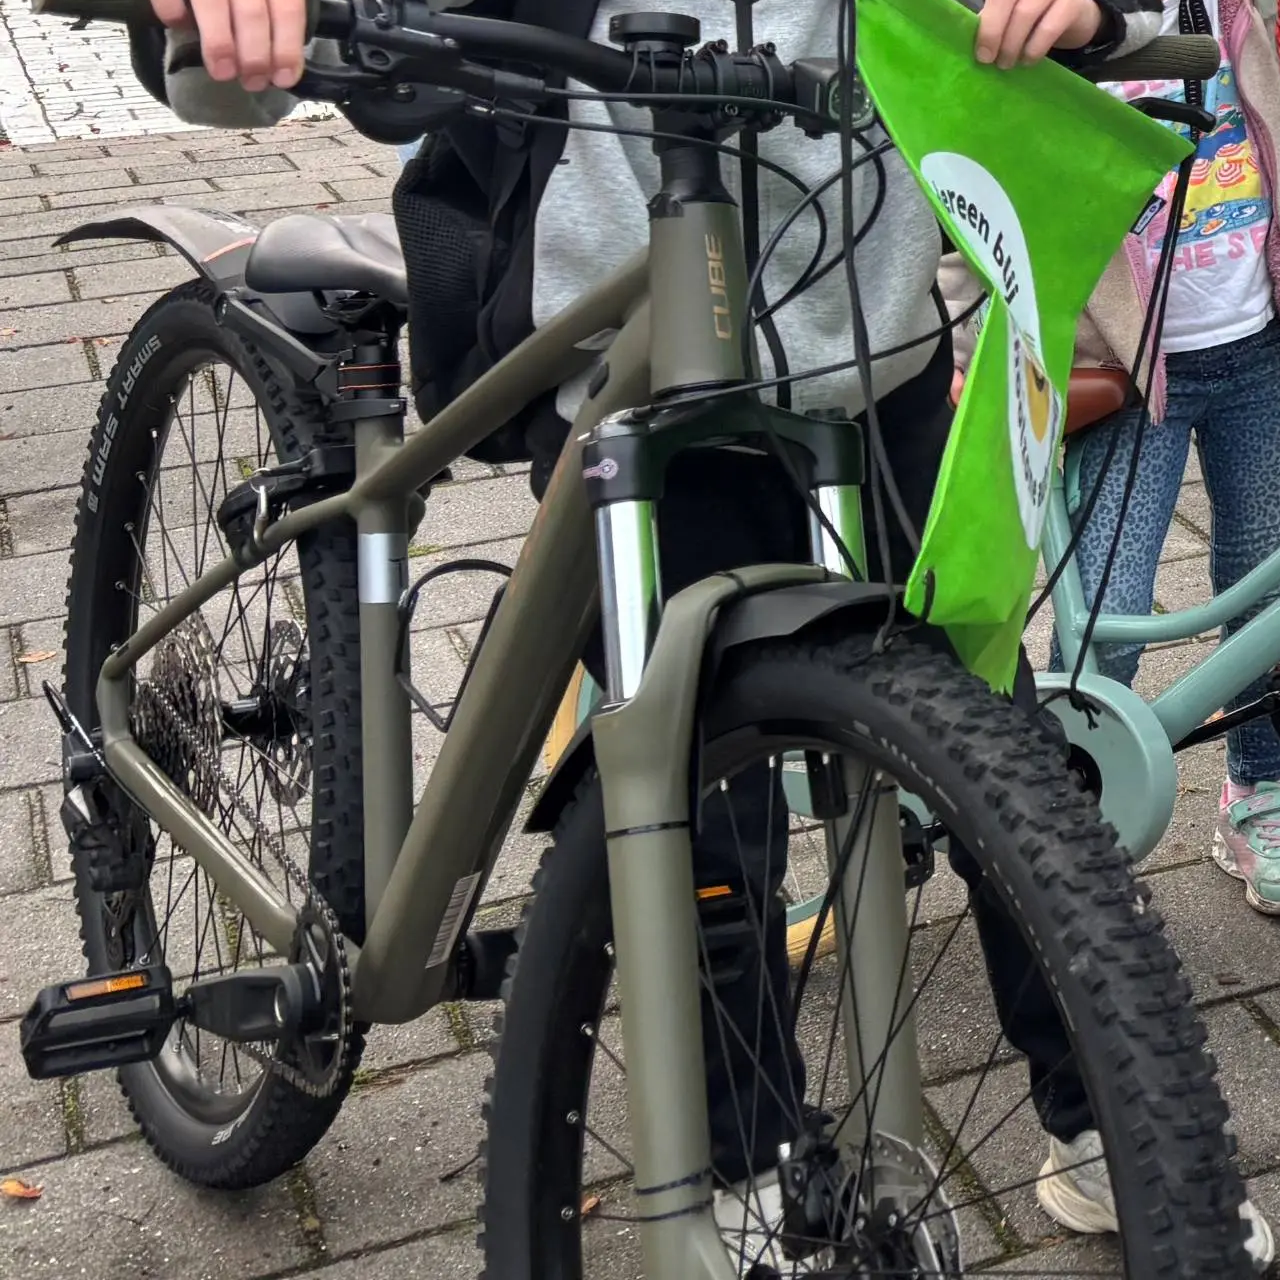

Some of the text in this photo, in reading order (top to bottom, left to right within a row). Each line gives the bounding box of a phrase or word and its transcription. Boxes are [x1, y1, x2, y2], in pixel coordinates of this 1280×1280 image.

[704, 232, 733, 340] CUBE
[931, 180, 1019, 306] ereen blij
[92, 333, 163, 487] SMART SAM
